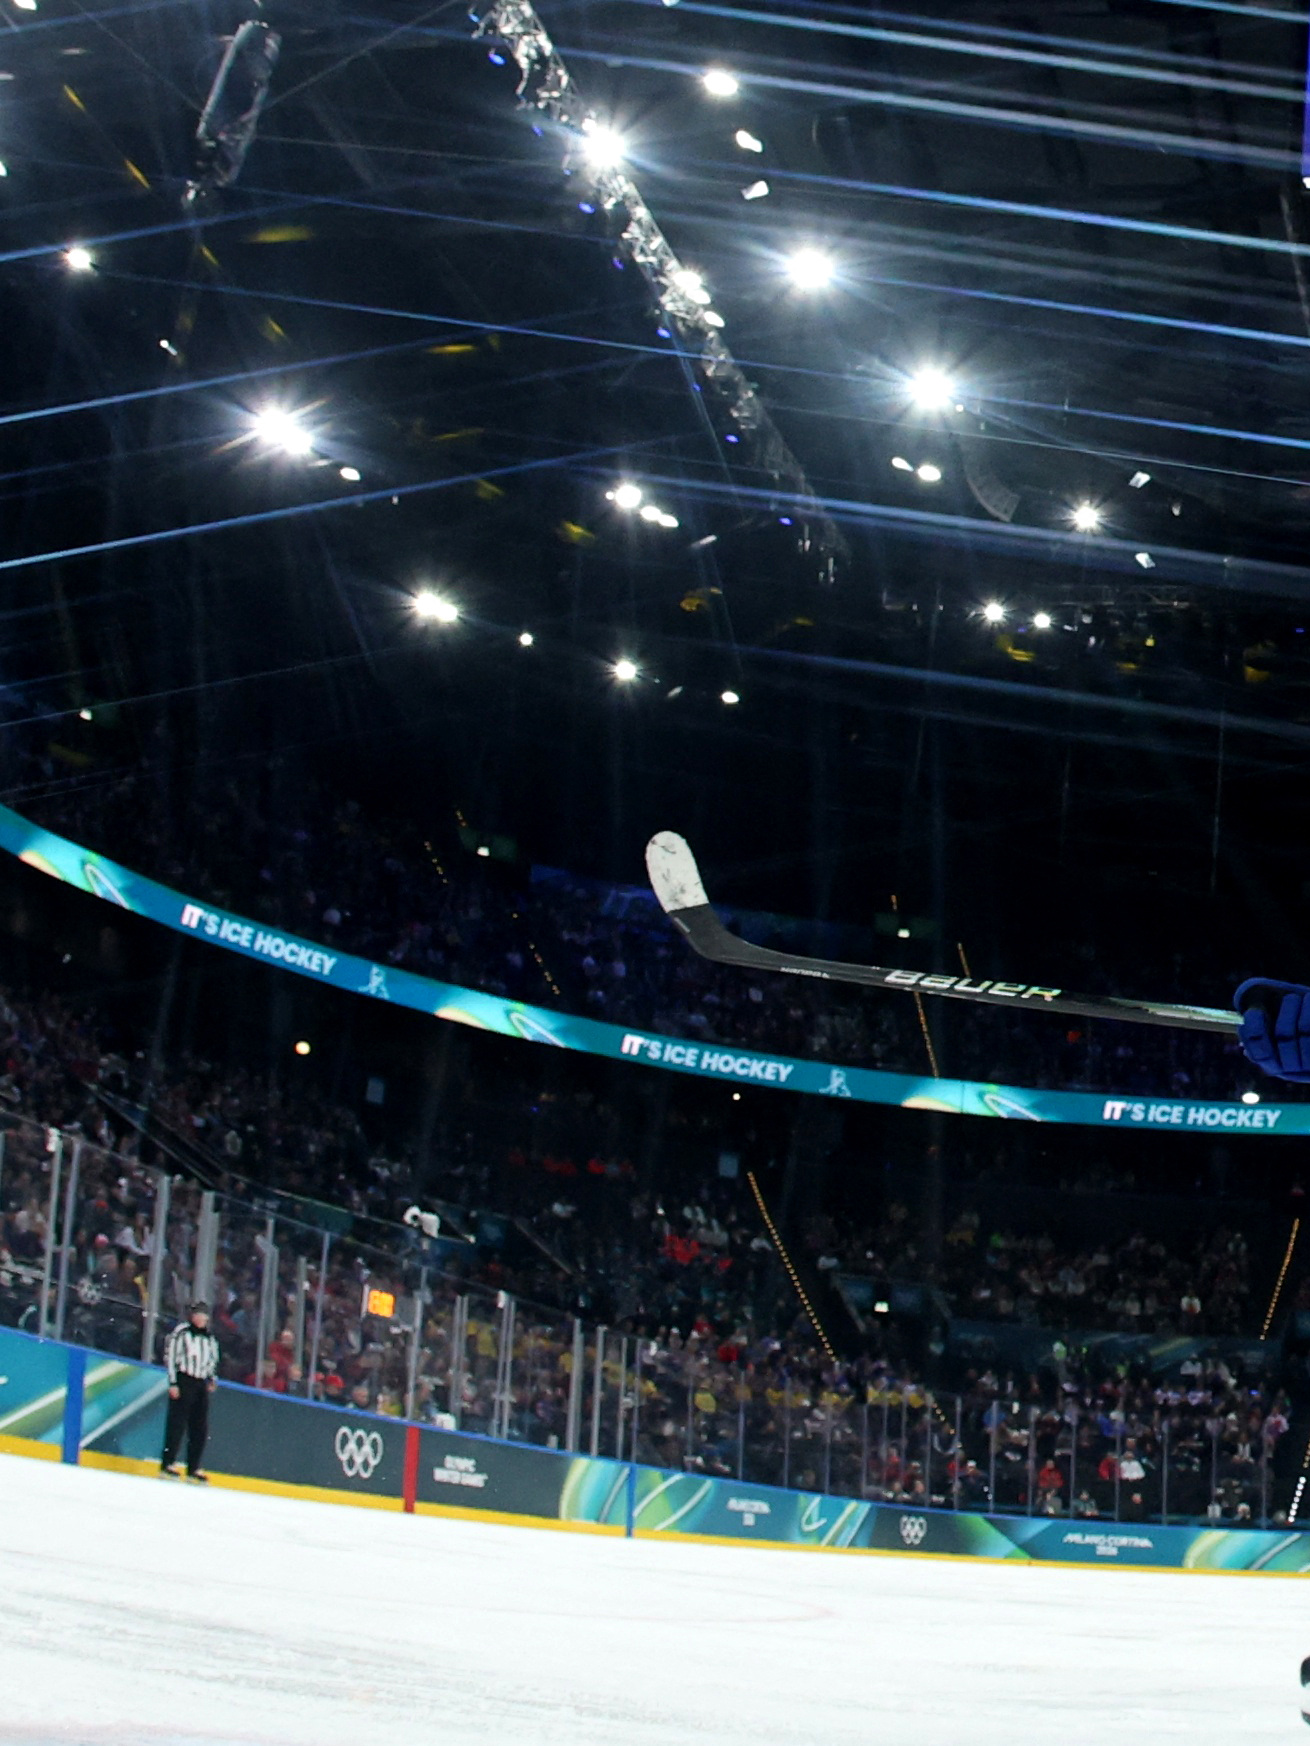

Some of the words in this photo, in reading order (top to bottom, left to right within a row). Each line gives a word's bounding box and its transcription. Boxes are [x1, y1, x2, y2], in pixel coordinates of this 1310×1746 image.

[180, 903, 221, 936] IT'S
[218, 918, 255, 948] ICE
[253, 930, 338, 977] HOCKEY
[884, 969, 1061, 1002] BAUER
[621, 1033, 662, 1060] IT'S
[662, 1043, 700, 1068] ICE
[700, 1051, 794, 1083] HOCKEY
[1103, 1100, 1145, 1122] IT'S
[1147, 1105, 1185, 1125] ICE
[1186, 1106, 1282, 1129] HOCKEY
